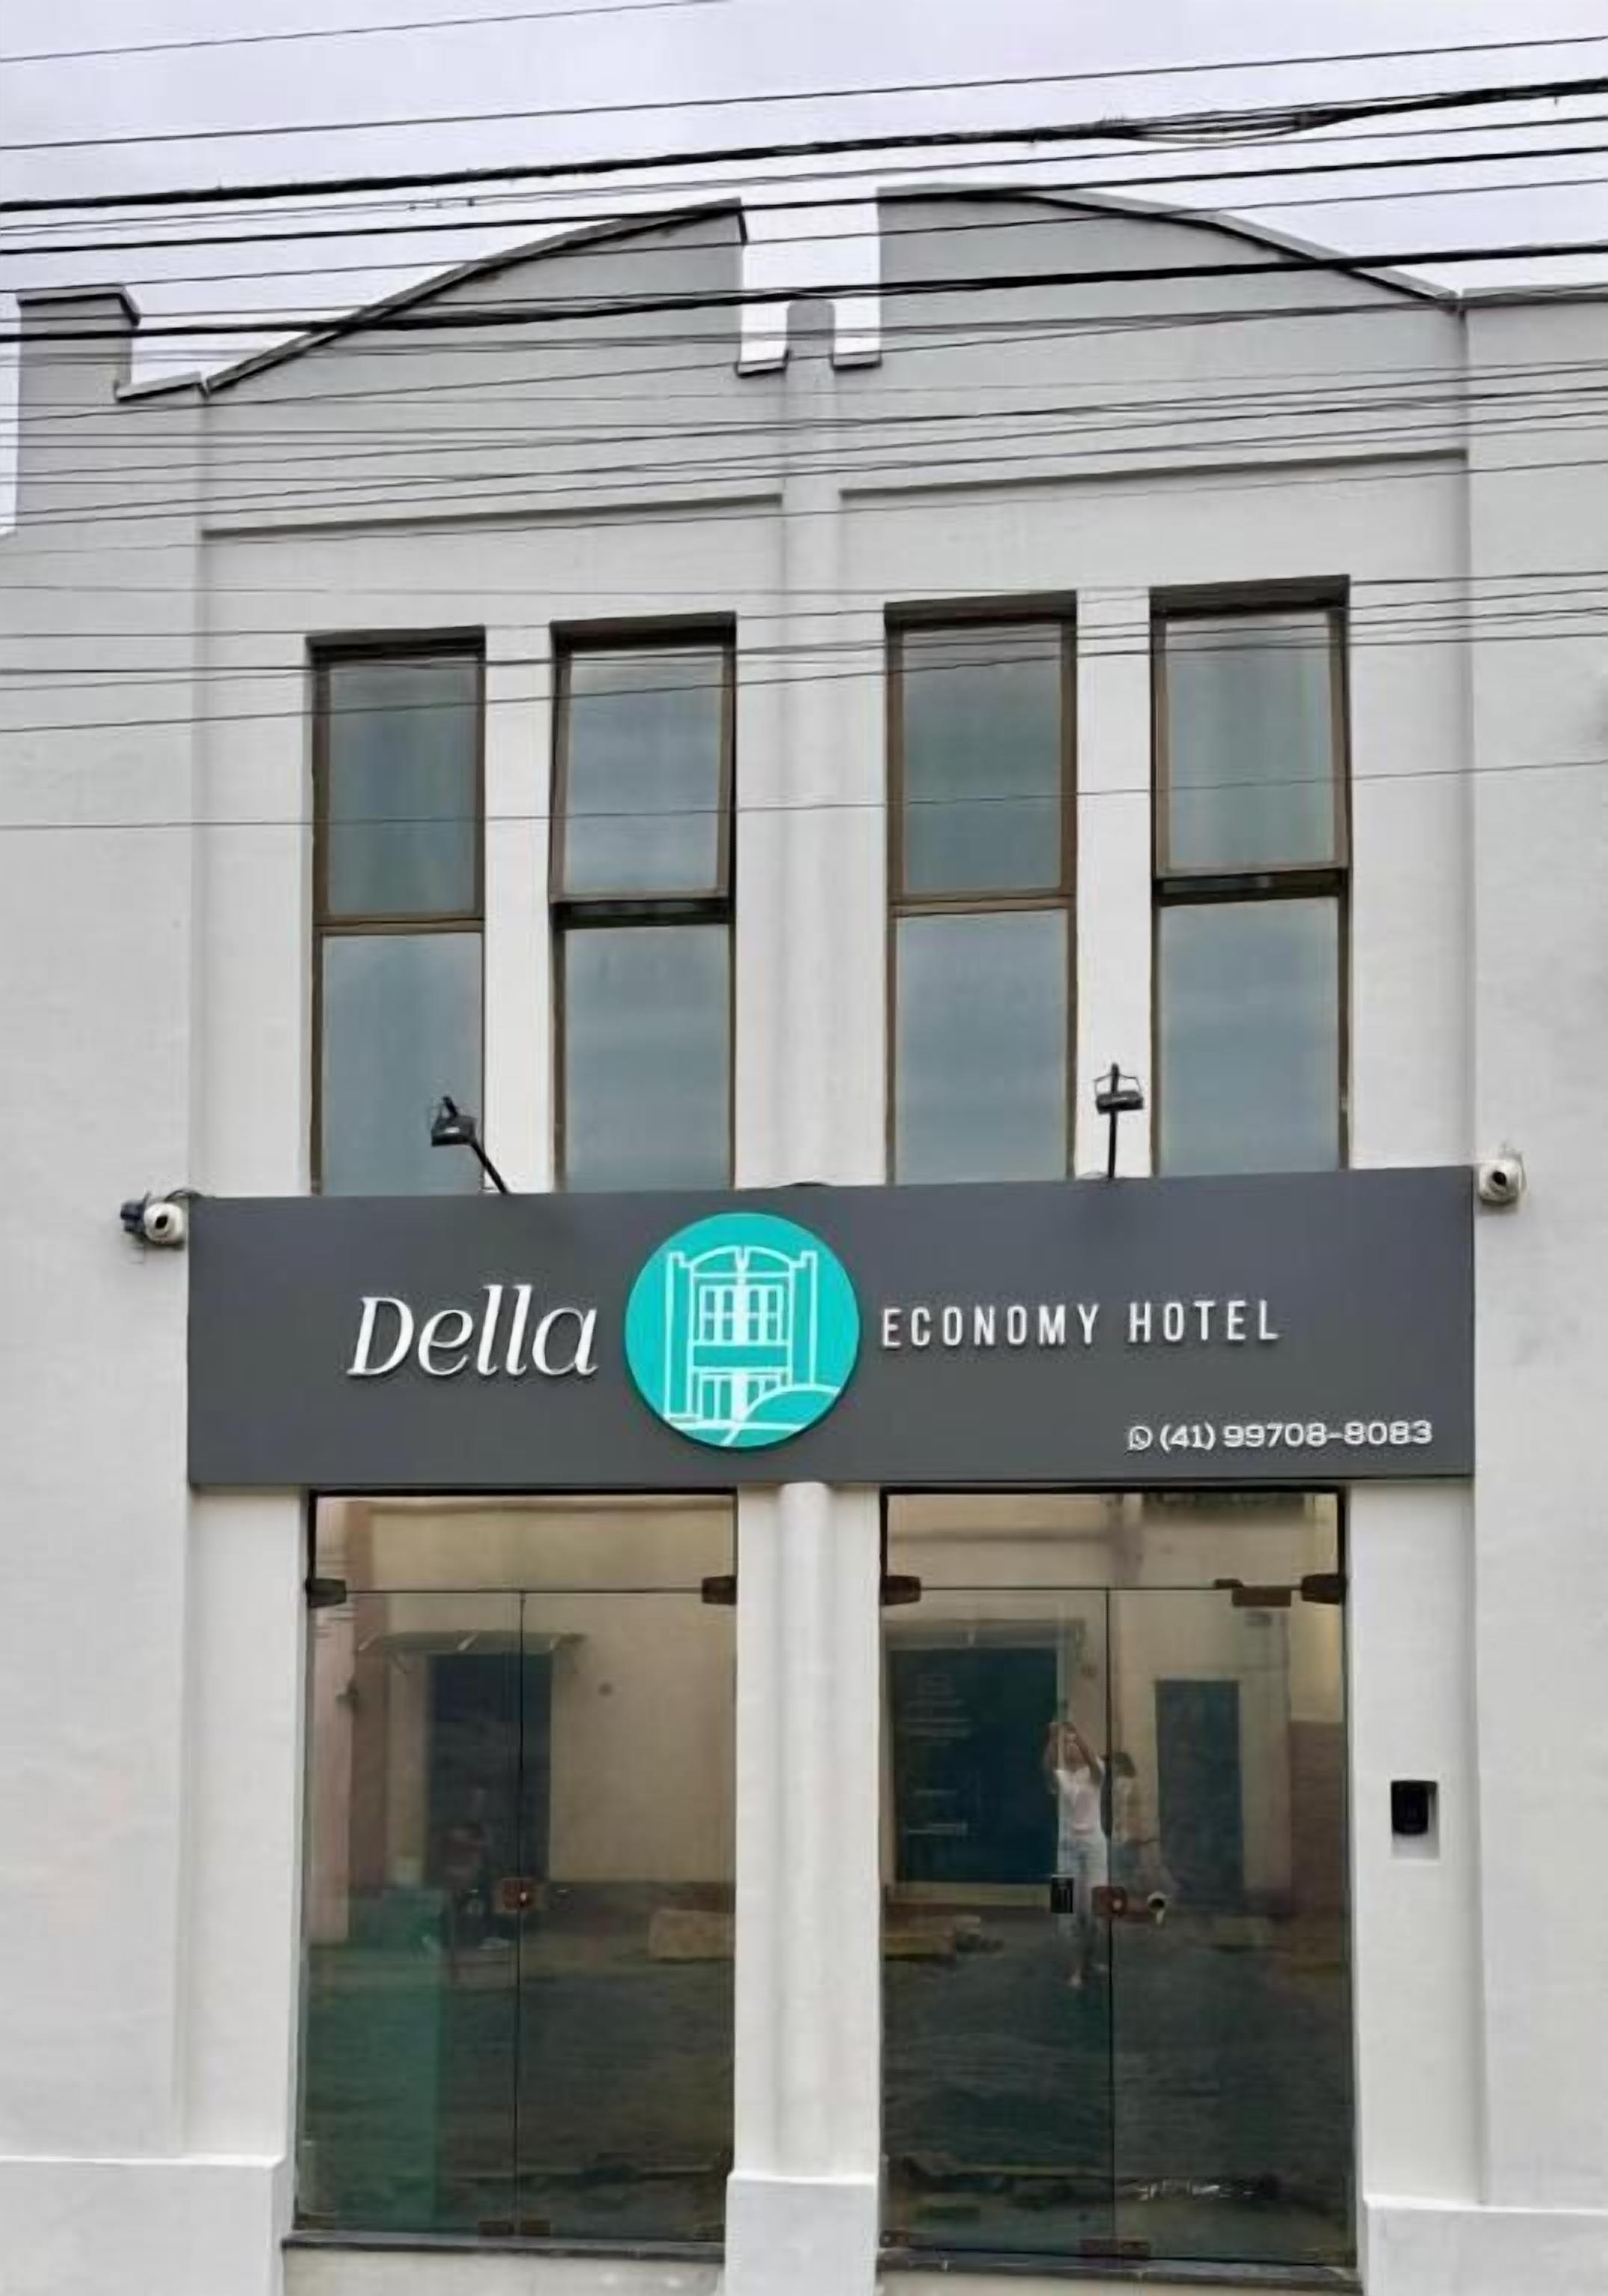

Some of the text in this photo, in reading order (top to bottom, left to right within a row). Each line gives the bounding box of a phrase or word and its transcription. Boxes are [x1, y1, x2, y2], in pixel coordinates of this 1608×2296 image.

[347, 1284, 598, 1377] Della
[882, 1299, 1280, 1348] ECONOMY HOTEL
[1159, 1419, 1434, 1451] (41) 99708-8083
